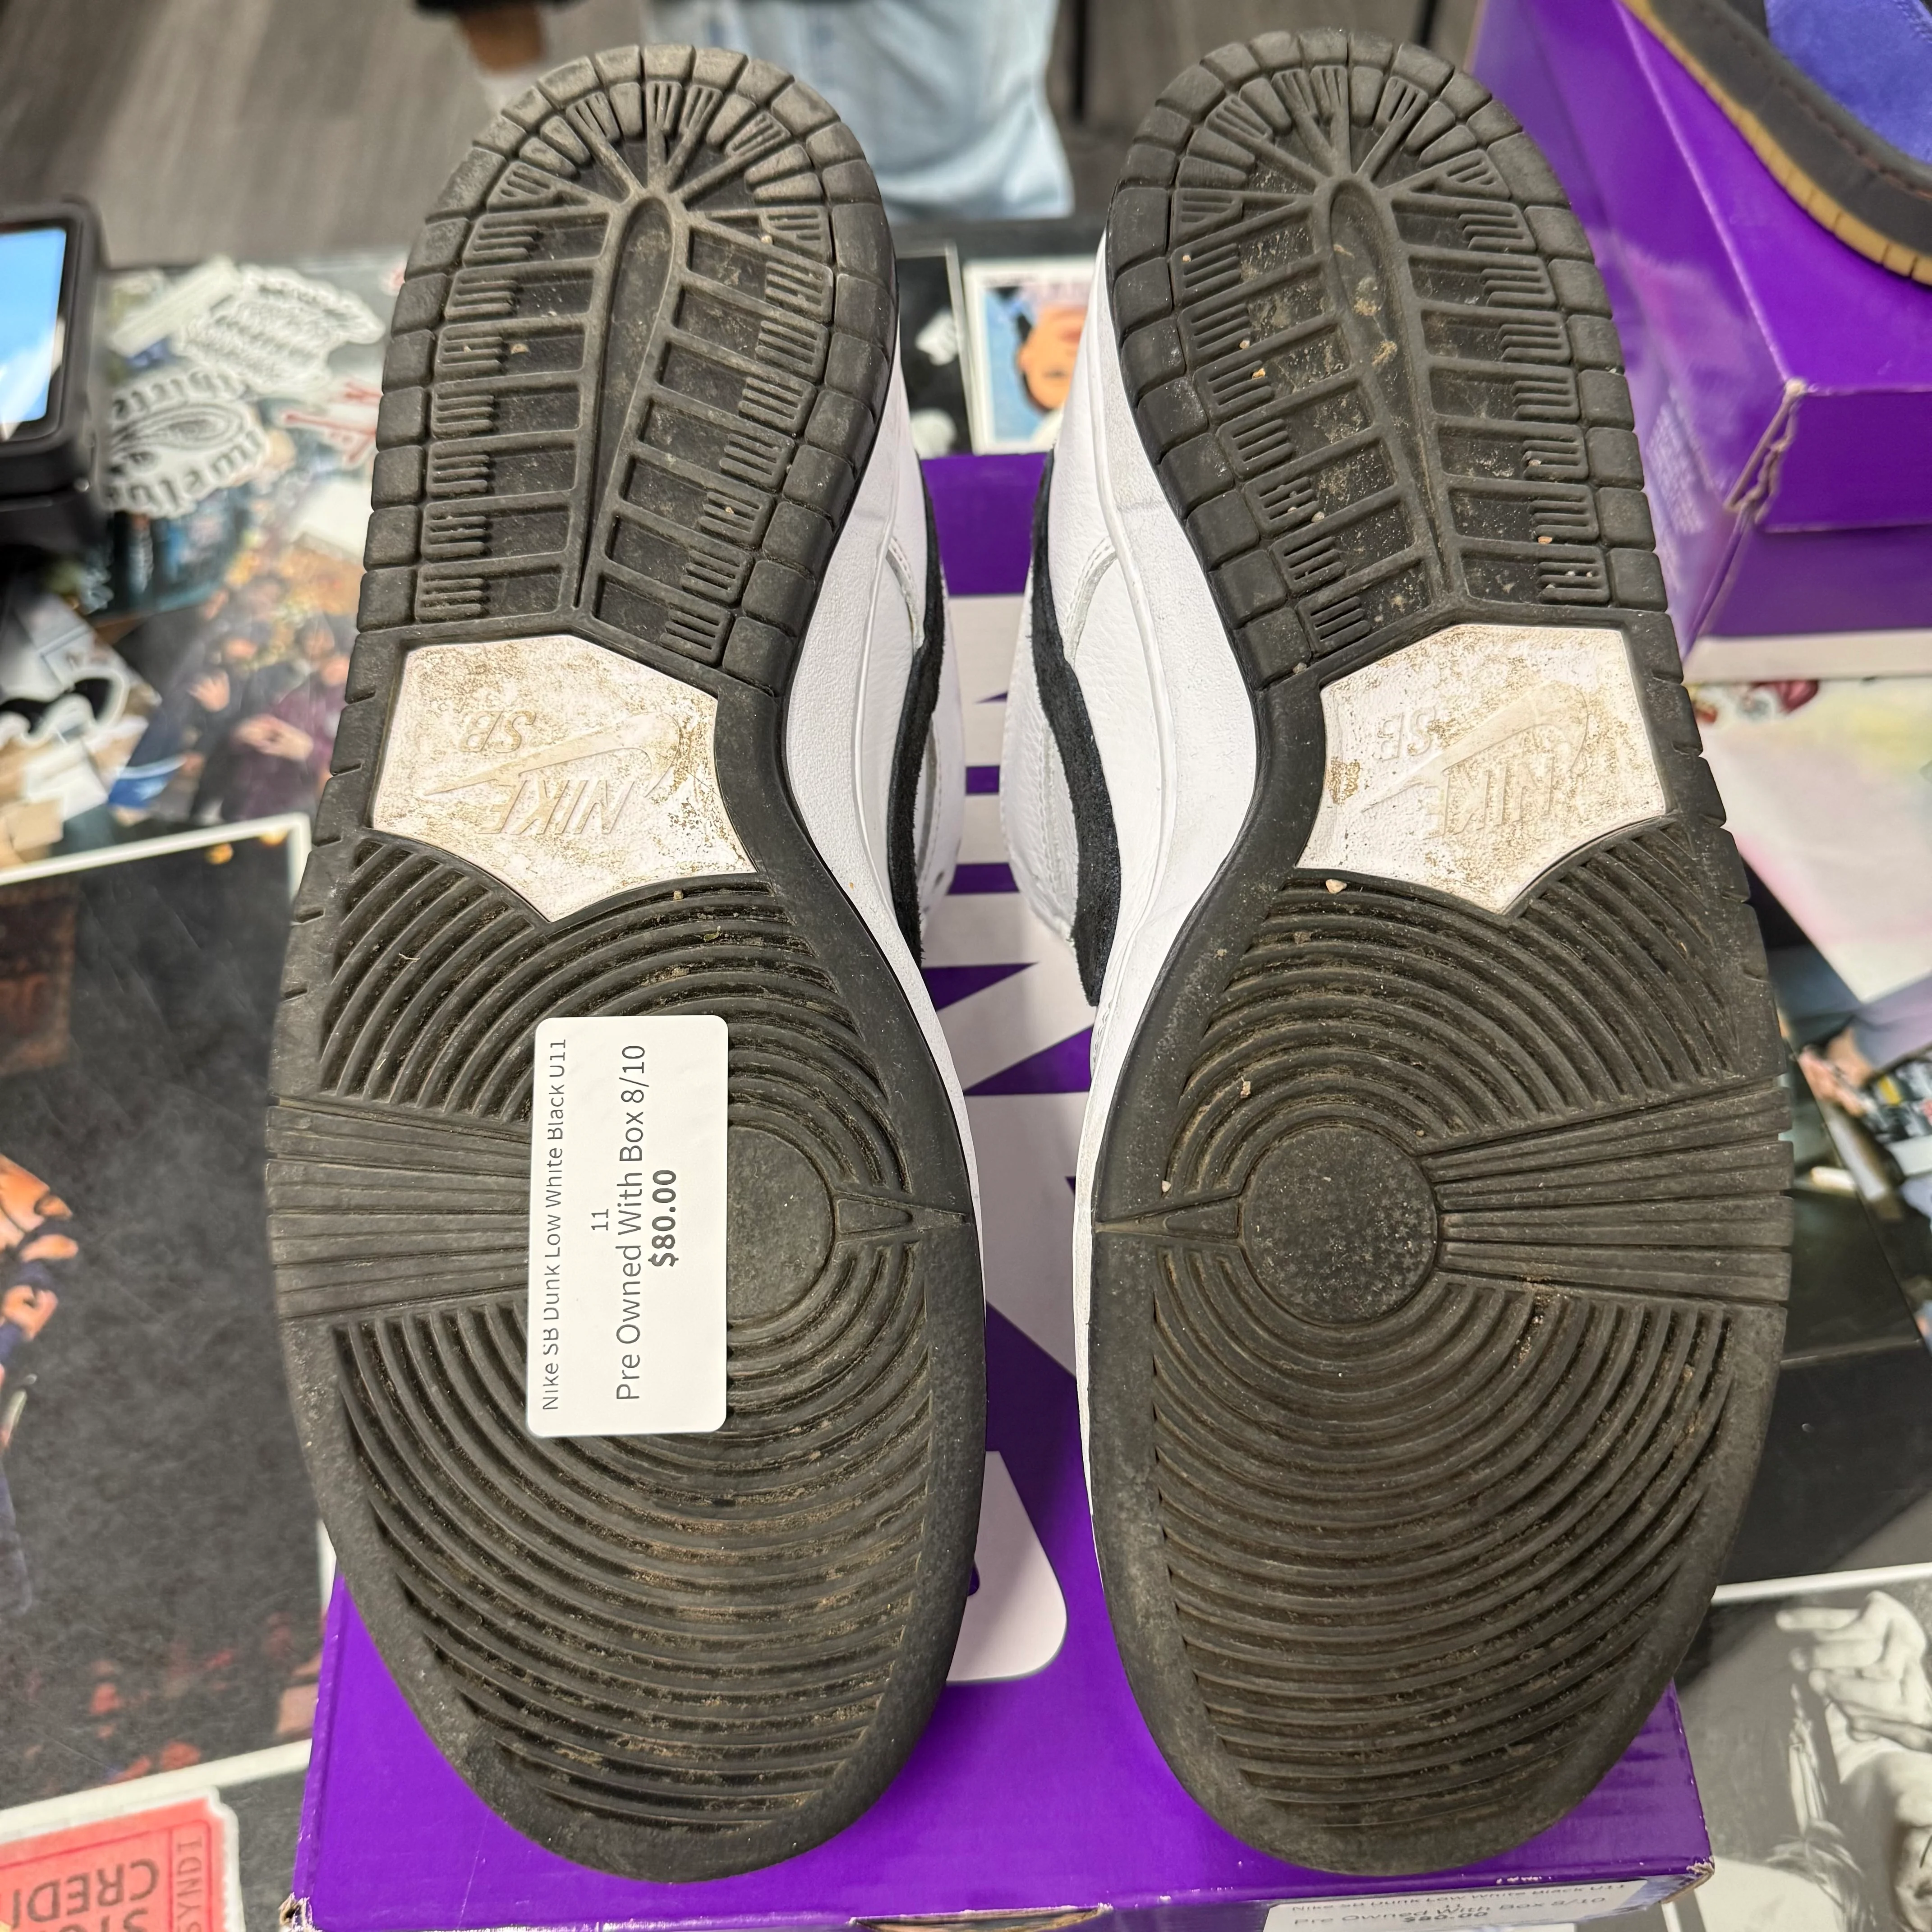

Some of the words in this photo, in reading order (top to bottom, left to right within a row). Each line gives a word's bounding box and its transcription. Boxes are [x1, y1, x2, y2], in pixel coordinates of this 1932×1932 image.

[458, 710, 537, 754] SB
[1371, 705, 1437, 762] SB
[549, 1039, 566, 1077] U11
[619, 1045, 649, 1103] 8/10
[547, 1084, 565, 1140] Black
[619, 1111, 644, 1161] Box
[546, 1148, 562, 1208] White
[616, 1173, 643, 1235] With
[545, 1214, 561, 1257] Low
[591, 1209, 609, 1231] 11
[648, 1170, 679, 1267] $80.00
[544, 1265, 560, 1320] Dunk
[615, 1245, 641, 1344] Owned
[543, 1328, 559, 1355] SB
[543, 1363, 559, 1410] Nike
[616, 1354, 640, 1399] Pre
[1, 1858, 160, 1931] CREDI
[1341, 1910, 1428, 1921] Owned
[1436, 1905, 1490, 1914] With
[1499, 1902, 1544, 1910] Box
[1551, 1897, 1605, 1907] 8/10
